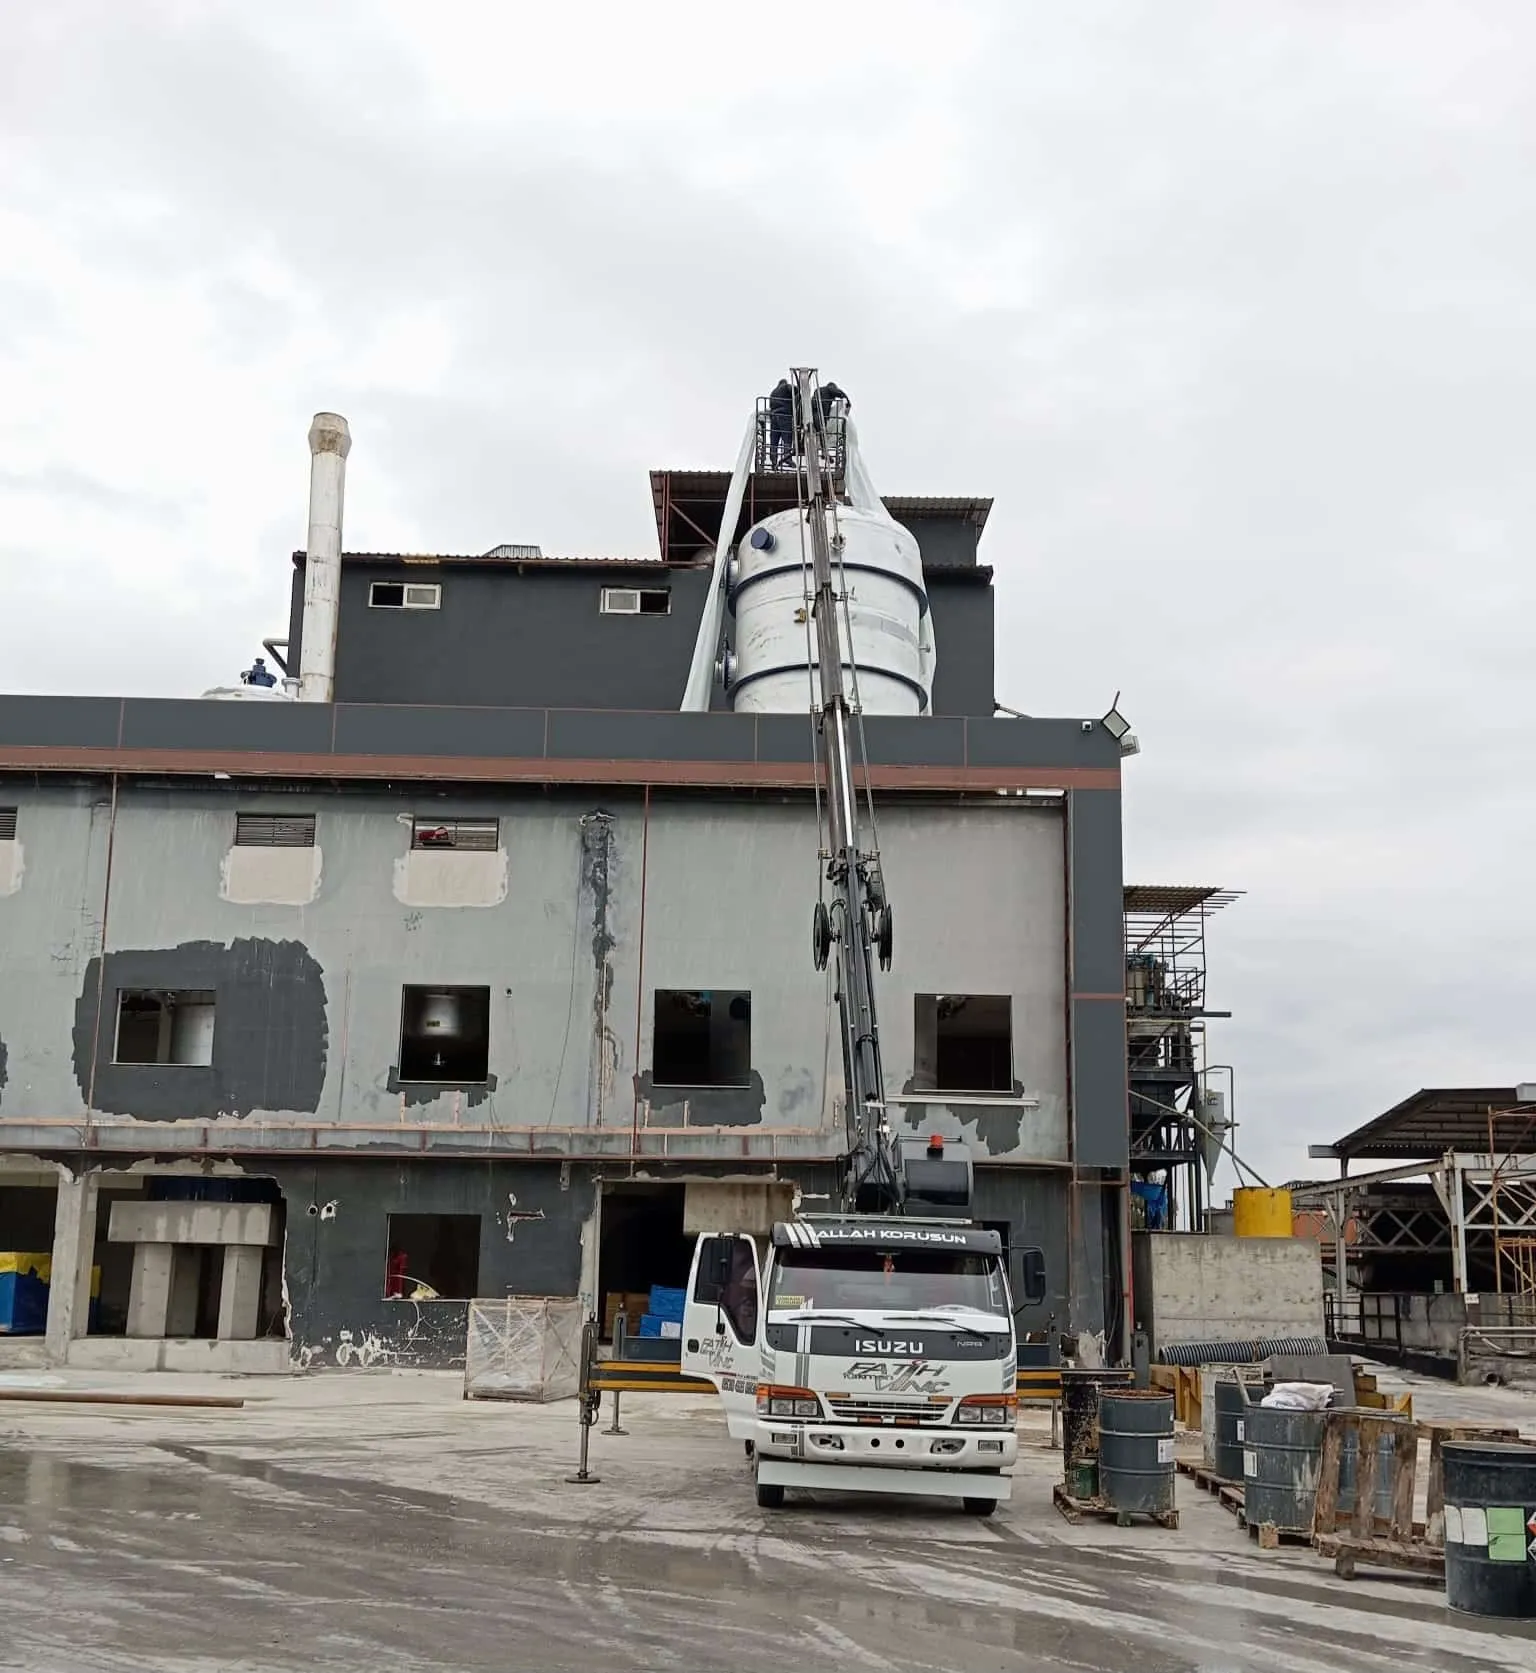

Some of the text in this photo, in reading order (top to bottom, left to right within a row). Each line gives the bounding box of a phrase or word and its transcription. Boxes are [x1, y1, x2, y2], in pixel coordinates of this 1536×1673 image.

[815, 1230, 967, 1245] ALLAH KORUSUN
[855, 1339, 924, 1355] ISUZU
